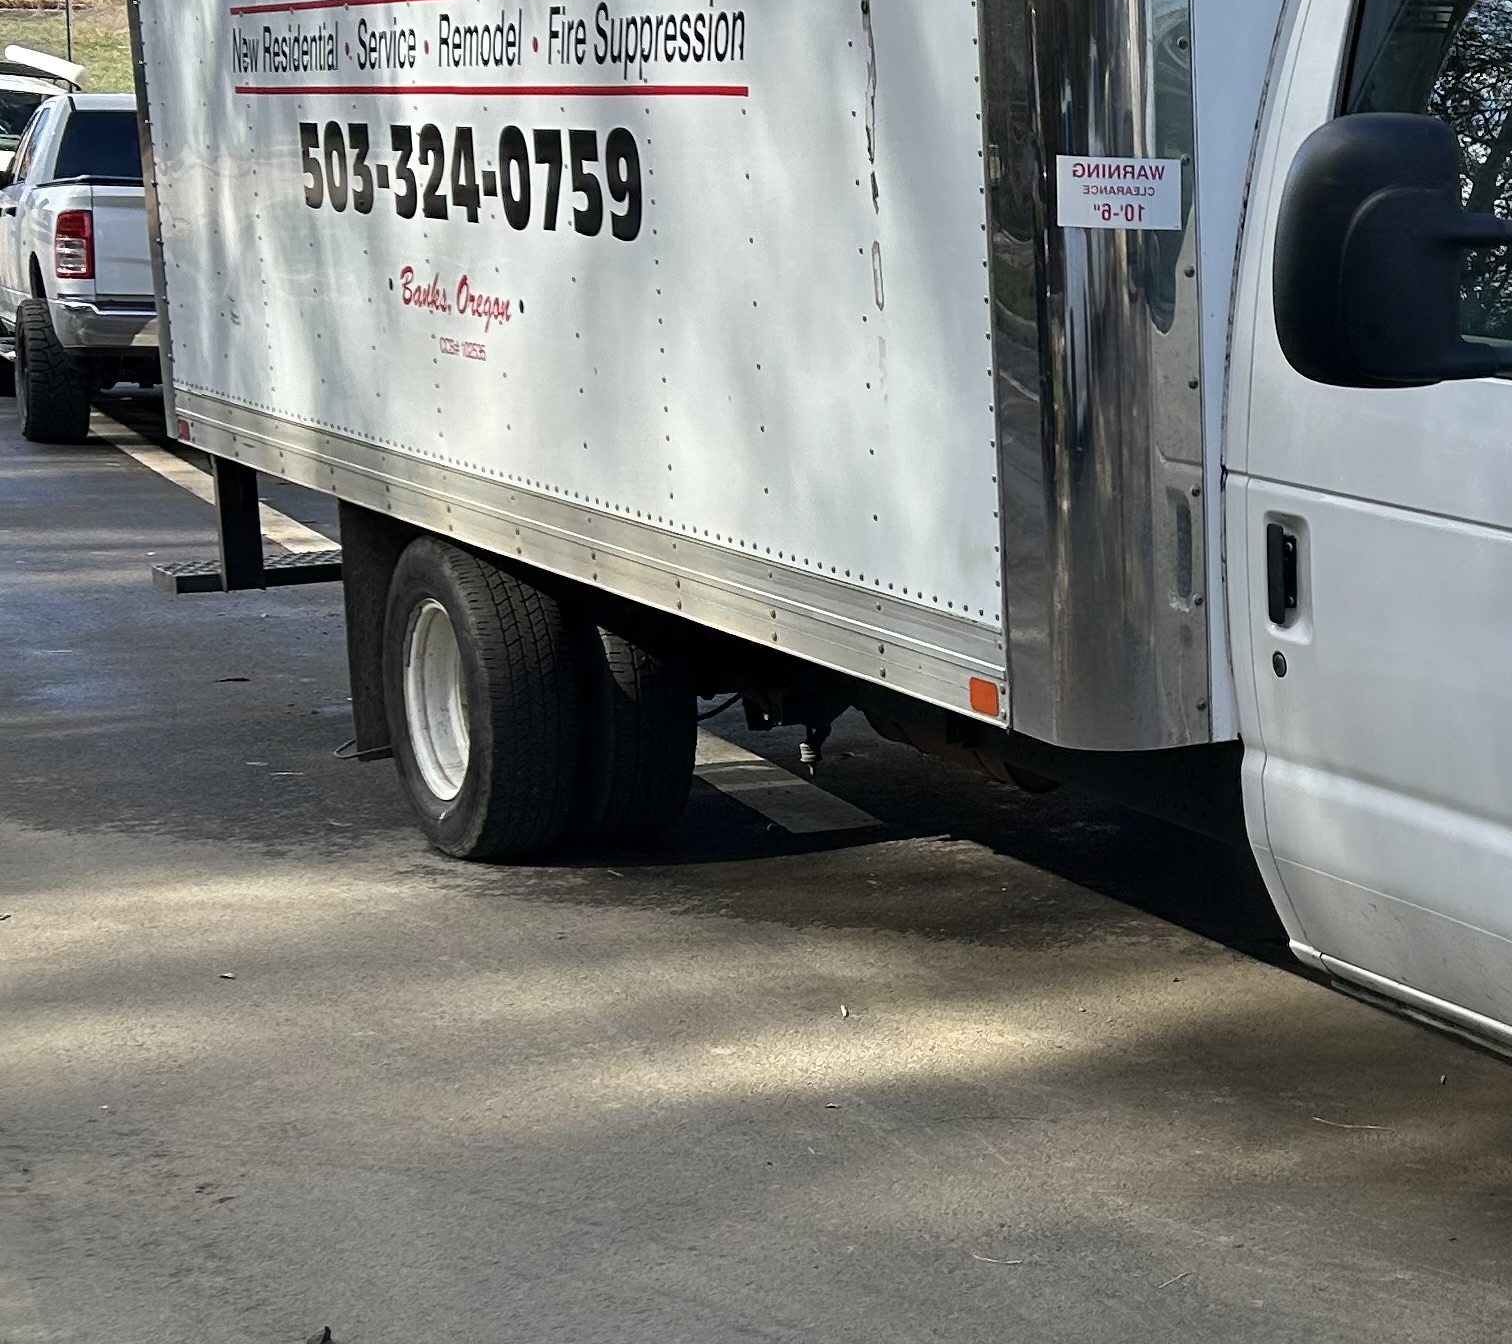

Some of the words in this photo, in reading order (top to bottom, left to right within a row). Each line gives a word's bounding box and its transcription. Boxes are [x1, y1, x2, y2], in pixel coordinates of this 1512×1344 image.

[232, 27, 260, 73] New
[262, 20, 339, 73] Residential
[357, 17, 417, 71] Service
[438, 8, 522, 67] Remodel
[547, 5, 587, 65] Fire
[299, 120, 643, 242] 503-324-0759
[456, 274, 512, 333] Oregon
